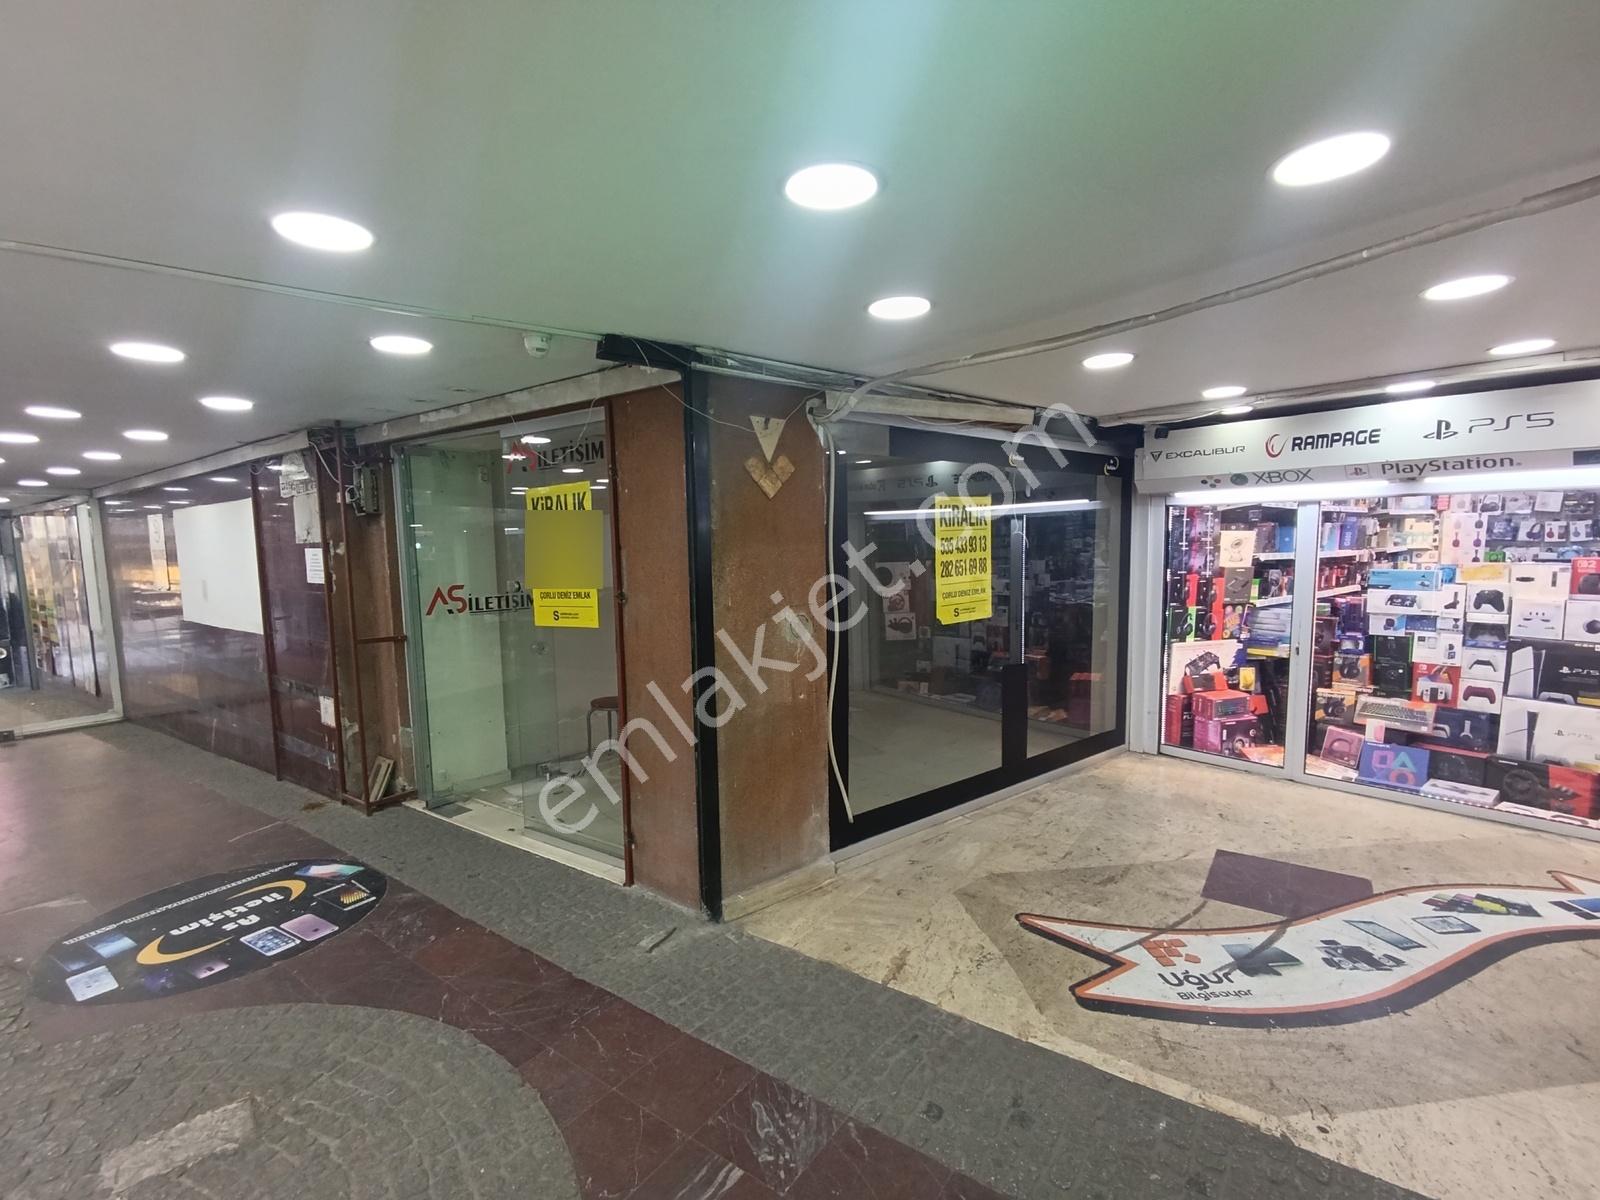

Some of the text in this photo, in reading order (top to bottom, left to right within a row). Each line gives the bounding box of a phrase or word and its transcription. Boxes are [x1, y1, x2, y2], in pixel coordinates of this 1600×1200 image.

[1468, 411, 1555, 434] PS5
[1291, 428, 1382, 452] RAMPAGE
[1165, 445, 1246, 460] EXCALIBUR
[1381, 454, 1515, 476] PlayStation
[1252, 468, 1315, 485] XBOX
[968, 535, 978, 553] 93
[979, 535, 987, 553] 13
[940, 560, 954, 578] 282
[955, 559, 967, 577] 651
[968, 558, 978, 576] 69
[573, 591, 591, 600] EMLAK
[1158, 969, 1235, 991] Uğur
[1177, 989, 1254, 1001] Bilgisayar
